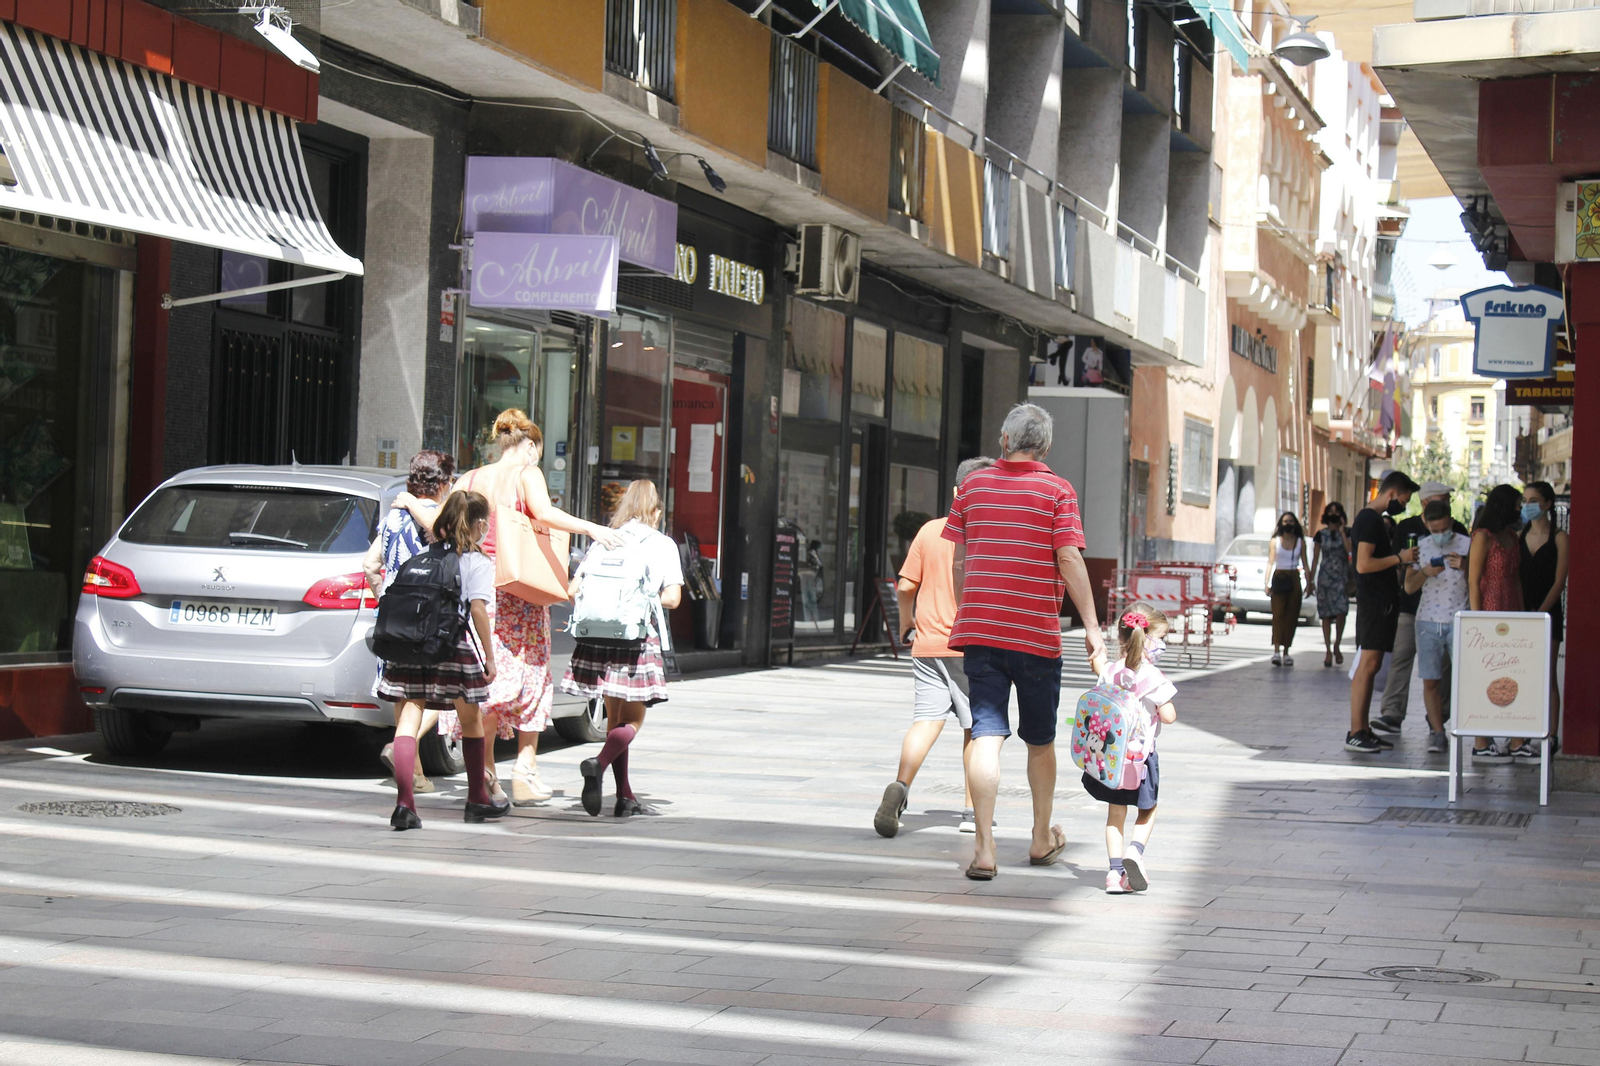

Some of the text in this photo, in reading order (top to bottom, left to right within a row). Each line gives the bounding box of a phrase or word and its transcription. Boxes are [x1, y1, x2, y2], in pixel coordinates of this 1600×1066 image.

[472, 181, 544, 214] Abril
[581, 188, 654, 258] Abril
[476, 239, 609, 299] Abril
[708, 253, 765, 306] PRIETO
[1484, 300, 1547, 319] friking
[201, 584, 236, 592] PEUGEOT
[184, 603, 230, 623] 0966
[237, 606, 274, 626] HZM
